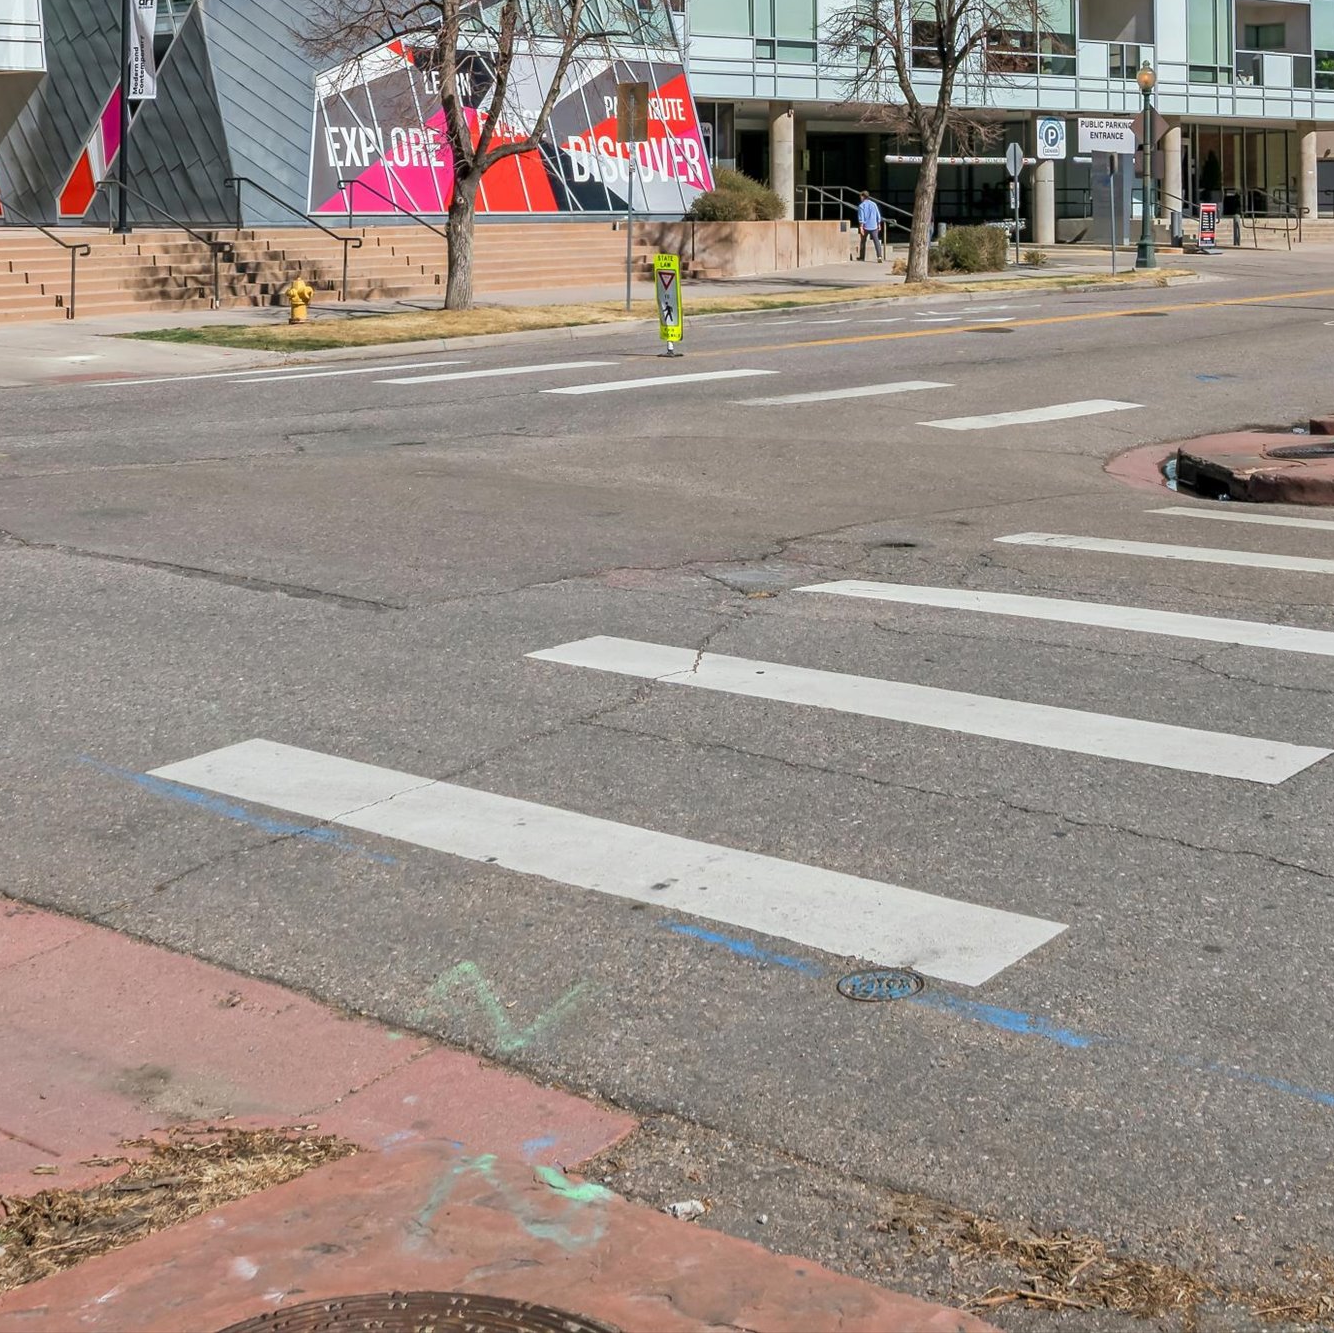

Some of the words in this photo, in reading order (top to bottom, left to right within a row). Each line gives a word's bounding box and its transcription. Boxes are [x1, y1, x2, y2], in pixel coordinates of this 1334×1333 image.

[138, 35, 146, 95] Contemporary
[423, 70, 472, 96] LERN
[1080, 120, 1104, 129] PUBLIC
[1105, 121, 1132, 129] PARKING
[1089, 132, 1124, 140] ENTRANCE
[325, 126, 445, 167] EXPLORE
[567, 135, 704, 183] DISCOVER
